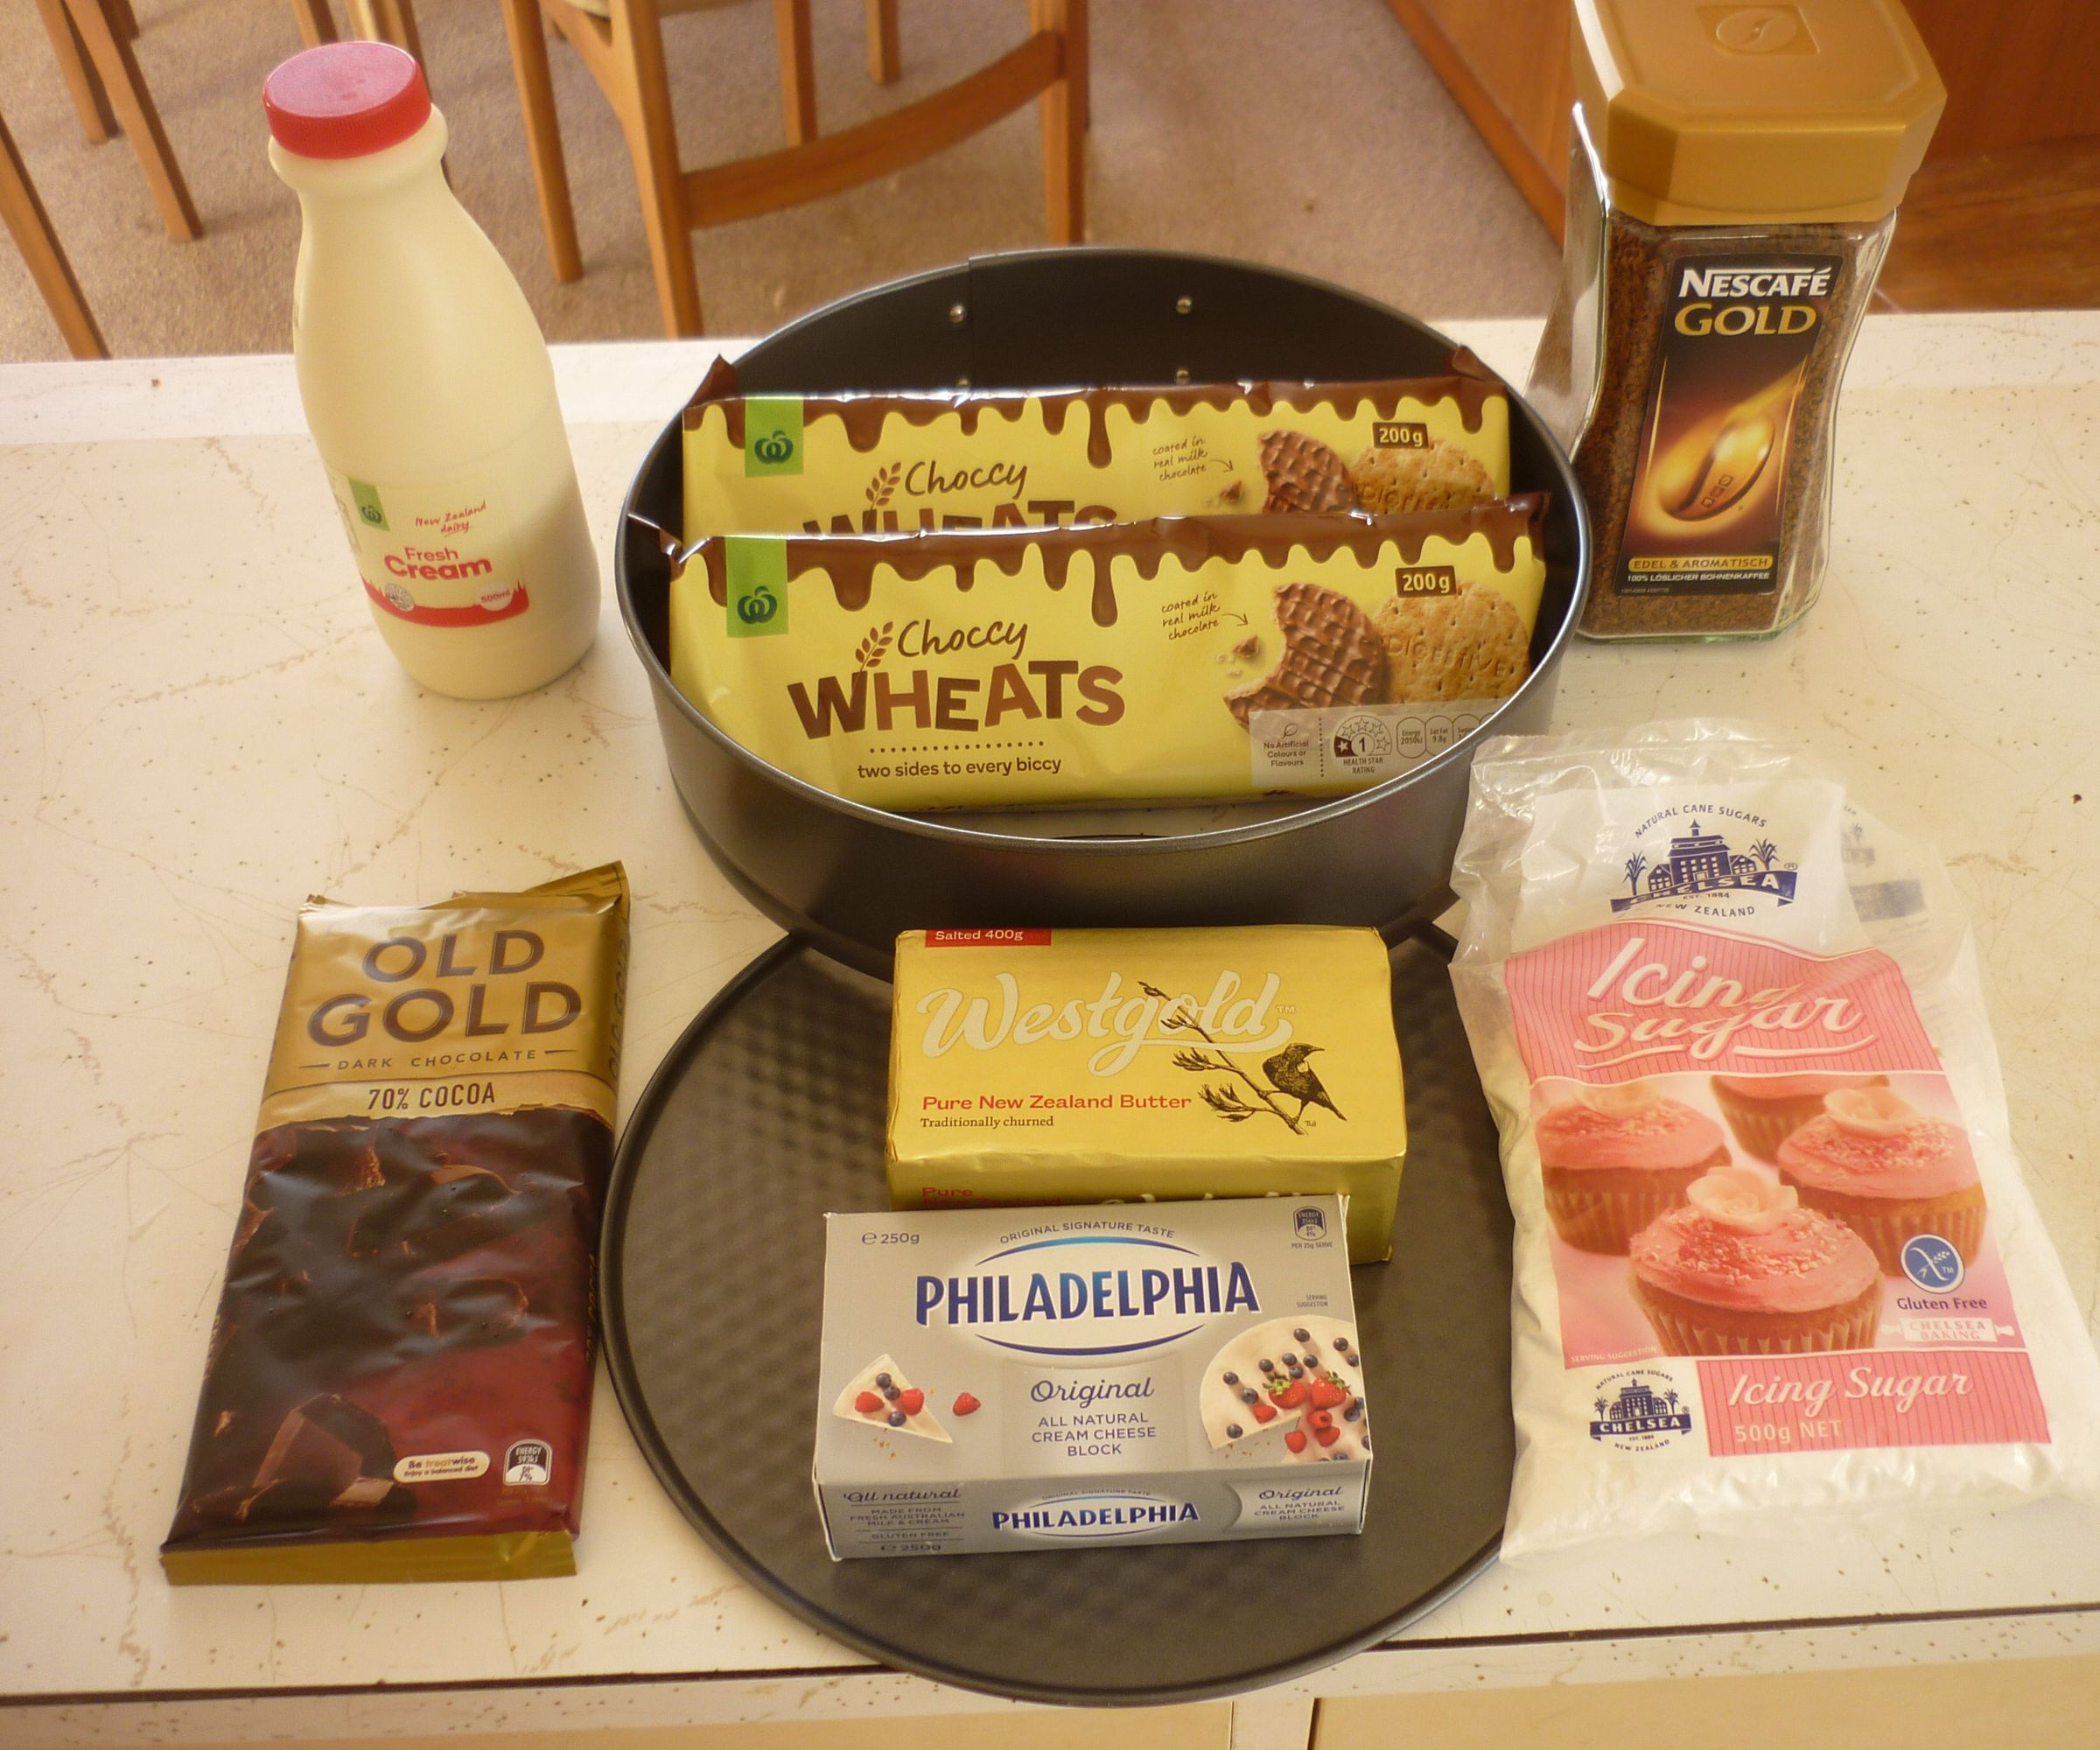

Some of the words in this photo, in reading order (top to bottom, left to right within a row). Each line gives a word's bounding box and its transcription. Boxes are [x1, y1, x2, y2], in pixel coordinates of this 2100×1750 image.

[1678, 267, 1832, 298] NESCAFÉ
[1674, 302, 1817, 337] GOLD
[1152, 438, 1188, 455] coated
[1191, 436, 1206, 447] in
[1153, 455, 1174, 469] real
[1178, 447, 1208, 464] milk
[904, 460, 1029, 500] Choccy
[1158, 465, 1207, 481] chocolate
[415, 517, 441, 528] New
[444, 499, 486, 522] Zealand
[440, 520, 470, 534] dairy
[404, 546, 459, 562] Fresh
[383, 554, 494, 581] Cream
[1634, 560, 1667, 570] EDEL
[1670, 560, 1679, 569] &
[1682, 557, 1768, 569] AROMATISCH
[1700, 571, 1770, 581] BOHNENKAFFEE
[1161, 594, 1199, 613] coated
[1203, 591, 1218, 602] in
[1162, 612, 1184, 627] real
[1188, 602, 1221, 620] milk
[1168, 620, 1220, 640] chocolate
[897, 619, 1029, 661] Choccy
[787, 660, 1125, 740] WHEATS
[1358, 737, 1366, 753] 1
[857, 764, 891, 780] two
[894, 760, 940, 777] sides
[942, 760, 962, 775] to
[965, 760, 1012, 779] every
[1015, 756, 1062, 774] biccy
[1270, 759, 1304, 767] Flavours
[1634, 807, 1679, 839] NATURAL
[1682, 804, 1714, 814] CANE
[1718, 805, 1768, 828] SUGARS
[1694, 906, 1755, 917] ZEALAND
[934, 930, 981, 941] Salted
[984, 929, 1024, 942] 400g
[361, 929, 545, 983] OLD
[307, 981, 582, 1047] GOLD
[915, 969, 1294, 1077] Westgold
[1573, 996, 1863, 1060] Sugar
[338, 1057, 393, 1070] DARK
[410, 1049, 536, 1068] CHOCOLATE
[367, 1088, 410, 1110] 70%
[418, 1082, 496, 1110] COCOA
[922, 1096, 973, 1110] Pure
[978, 1095, 1025, 1110] New
[1029, 1094, 1113, 1110] Zealand
[1119, 1094, 1193, 1109] Butter
[920, 1116, 1001, 1130] Traditionally
[1003, 1116, 1054, 1128] churned
[921, 1186, 974, 1197] Pure
[880, 1232, 920, 1245] 250g
[999, 1223, 1060, 1244] ORIGINAL
[1062, 1220, 1134, 1231] SIGNATURE
[1137, 1223, 1175, 1239] TASTE
[915, 1261, 1263, 1327] PHILADELPHIA
[1896, 1296, 1950, 1311] Gluten
[1953, 1297, 1988, 1310] Free
[1908, 1320, 1986, 1331] CHELSEA
[1920, 1330, 1981, 1340] BAKING
[1571, 1354, 1606, 1363] SERVING
[1607, 1346, 1659, 1360] SUGGESTION
[1595, 1371, 1625, 1390] NATURAL
[1647, 1368, 1674, 1382] SUGARS
[1031, 1376, 1155, 1409] Original
[1727, 1374, 1836, 1418] Icing
[1844, 1366, 1974, 1414] Sugar
[1038, 1416, 1068, 1427] ALL
[1073, 1411, 1149, 1425] NATURAL
[1599, 1416, 1682, 1433] CHELSEA
[1032, 1430, 1088, 1443] CREAM
[1094, 1426, 1157, 1440] CHEESE
[1734, 1423, 1791, 1443] 500g
[1799, 1419, 1842, 1438] NET
[1068, 1443, 1123, 1457] BLOCK
[1614, 1442, 1633, 1452] NEW
[1634, 1438, 1670, 1452] ZEALAND
[408, 1460, 422, 1469] Be
[844, 1491, 879, 1503] All
[882, 1488, 961, 1502] natural
[1258, 1486, 1344, 1501] Original
[1284, 1500, 1341, 1508] NATURAL
[1299, 1505, 1345, 1514] CHEESE
[991, 1502, 1200, 1530] PHILADELPHIA
